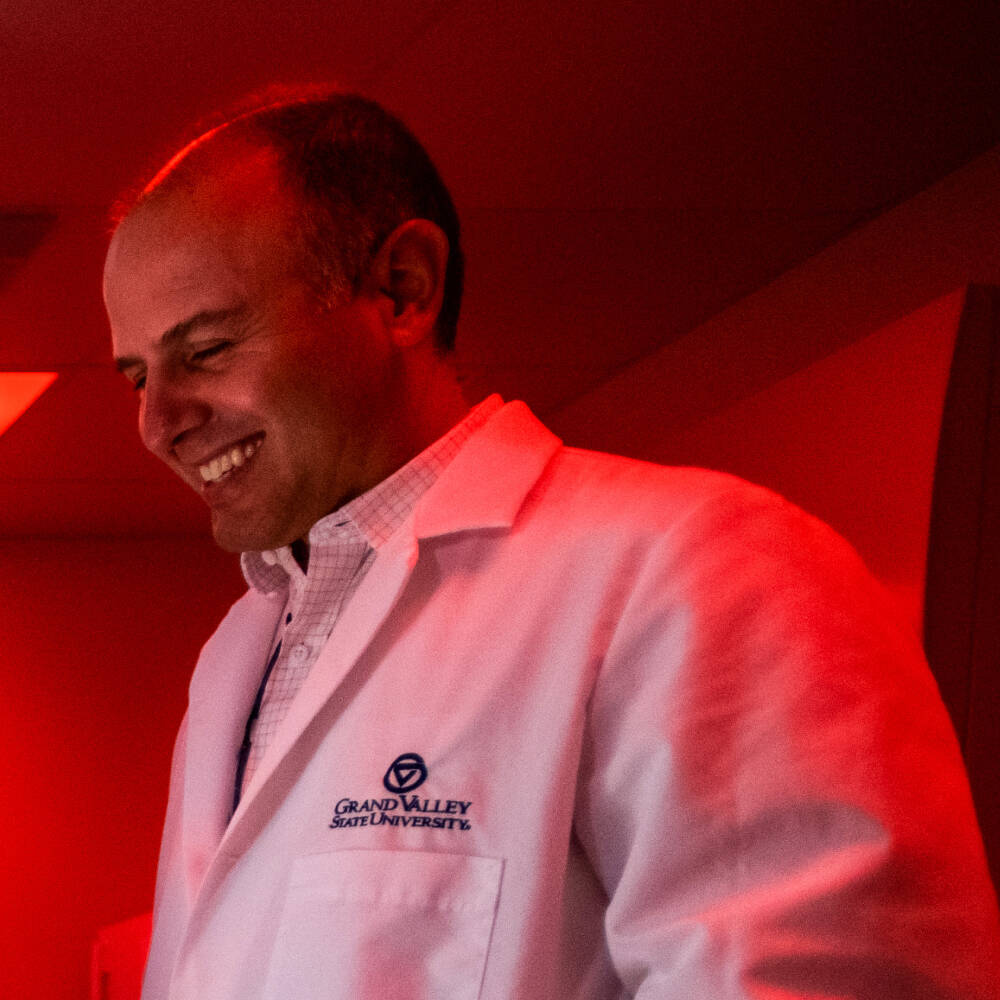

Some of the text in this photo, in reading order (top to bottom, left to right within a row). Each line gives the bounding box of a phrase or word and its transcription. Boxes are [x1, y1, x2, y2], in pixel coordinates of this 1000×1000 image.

[334, 794, 473, 815] GRAND VALLEY
[329, 815, 369, 829] STATE
